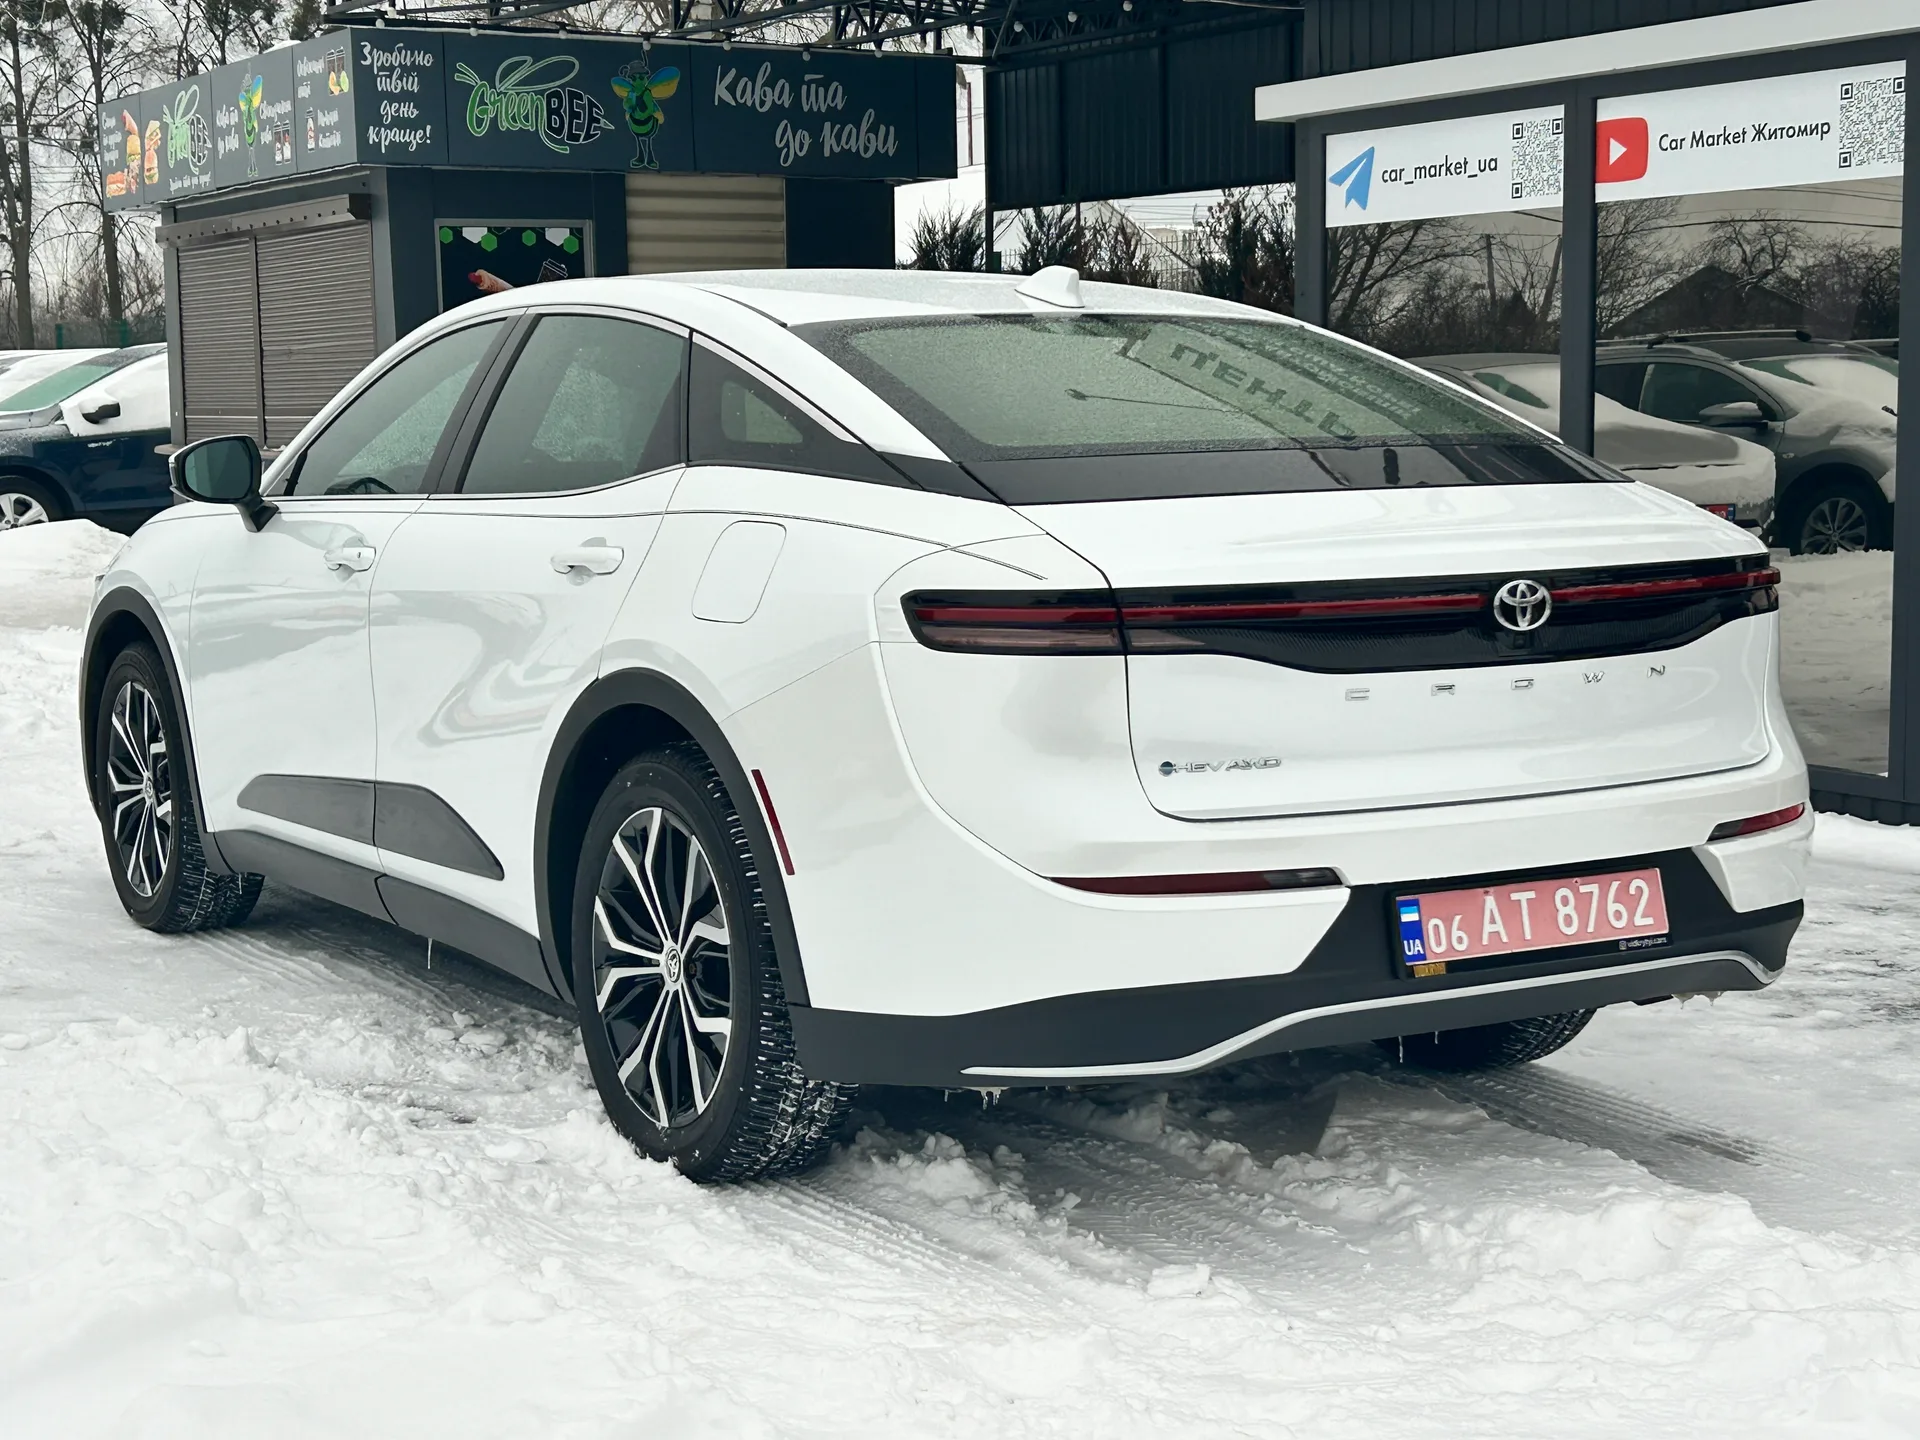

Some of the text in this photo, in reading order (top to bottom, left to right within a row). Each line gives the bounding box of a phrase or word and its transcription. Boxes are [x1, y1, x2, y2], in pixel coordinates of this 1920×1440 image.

[377, 67, 420, 93] твій
[714, 62, 848, 113] Кава та
[380, 100, 419, 125] день
[366, 125, 432, 154] краще!
[775, 108, 898, 167] до кави
[1658, 121, 1831, 151] Car Market Житомир
[1381, 154, 1498, 185] car_market_ua
[1427, 878, 1655, 954] 06 AT 8762
[1403, 938, 1424, 956] UA
